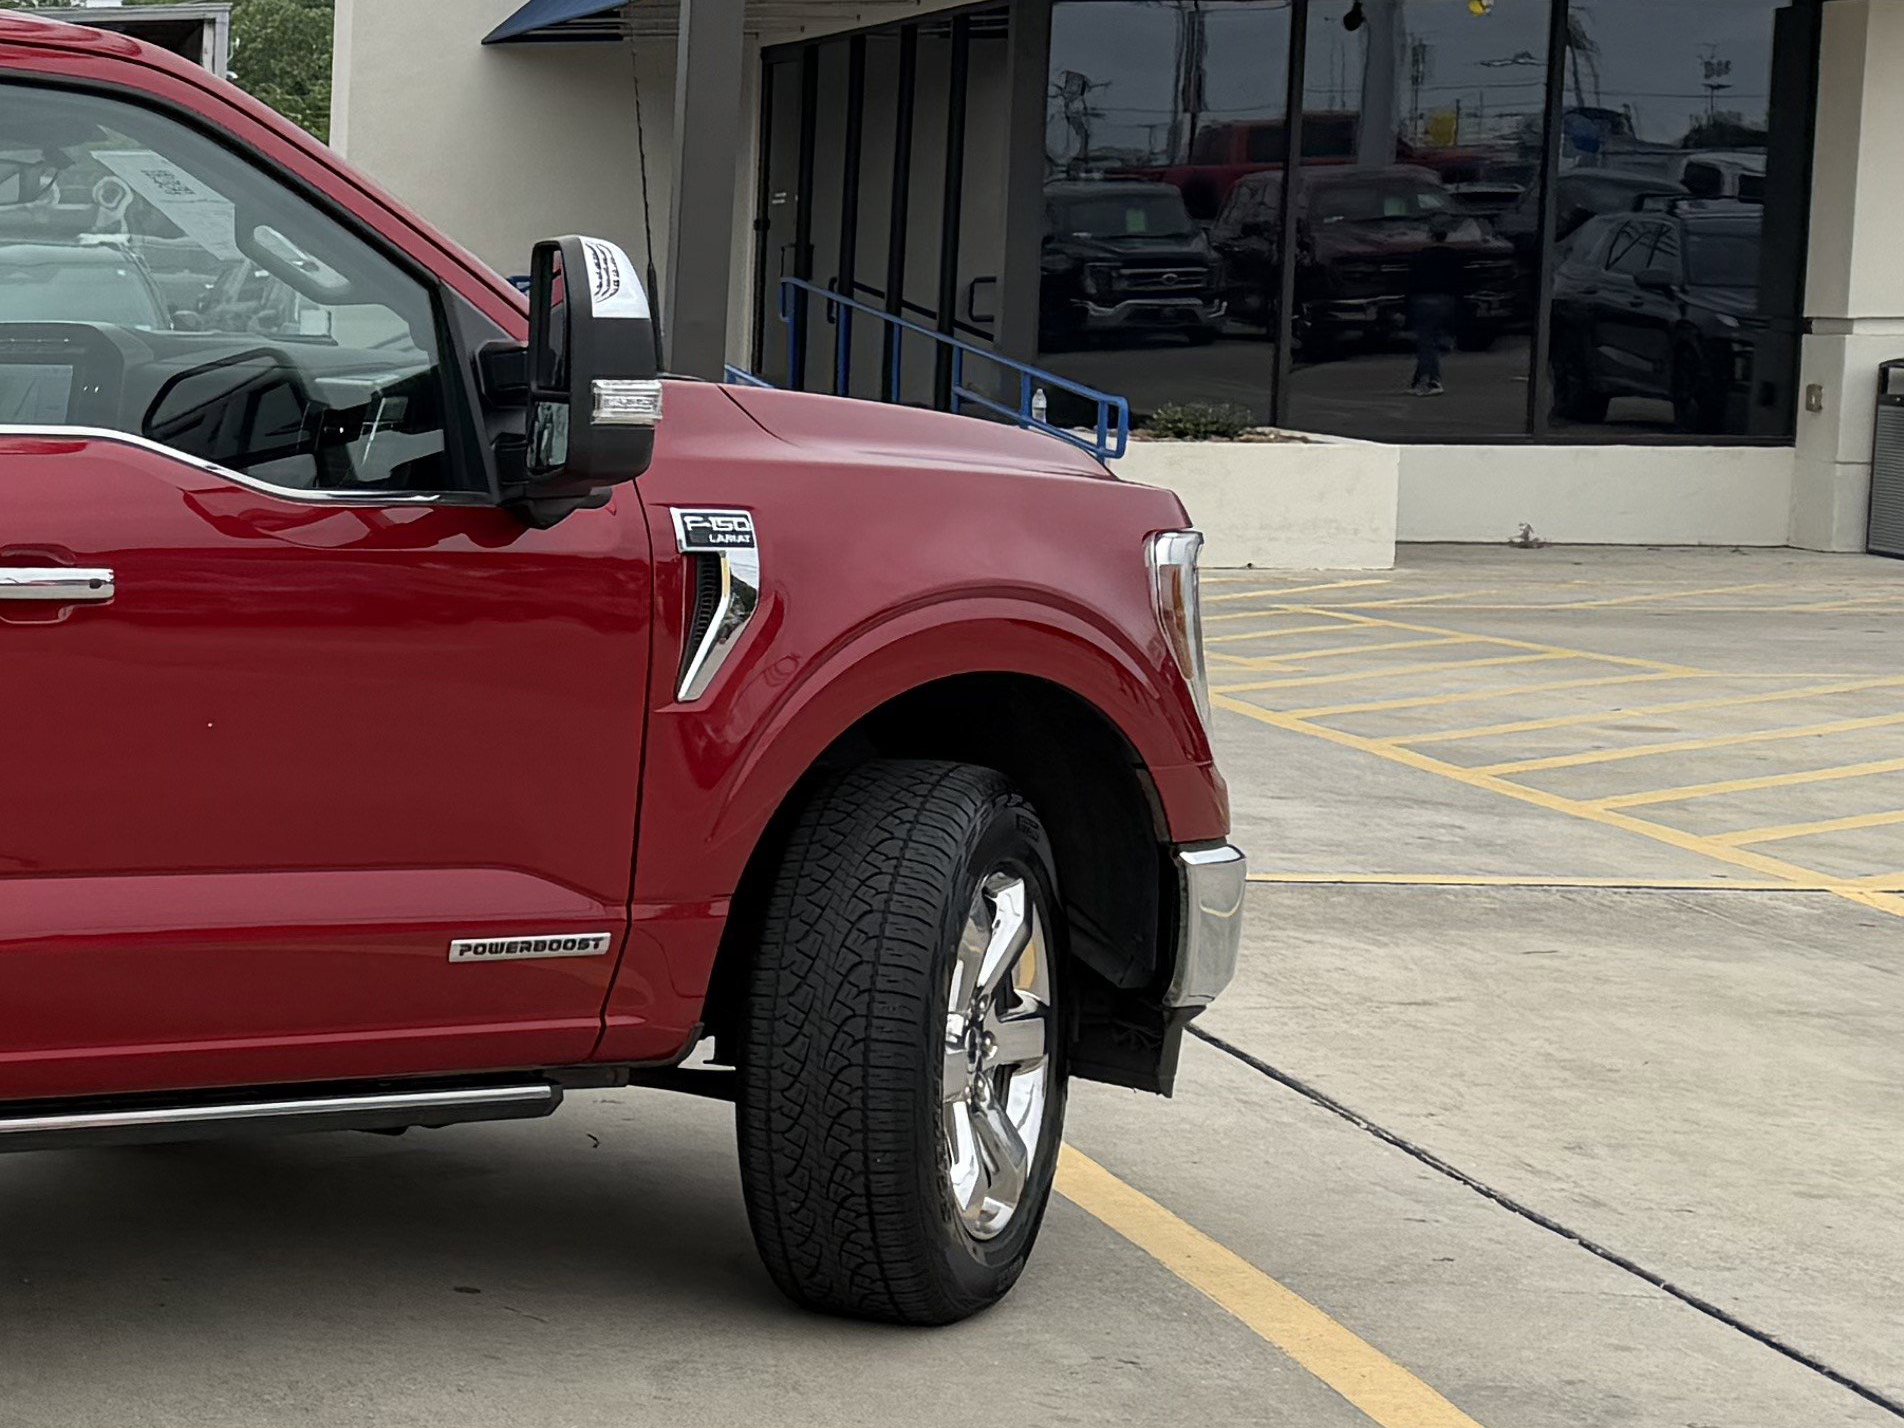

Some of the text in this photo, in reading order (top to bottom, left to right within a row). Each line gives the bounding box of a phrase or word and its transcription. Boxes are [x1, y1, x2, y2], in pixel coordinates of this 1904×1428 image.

[683, 515, 752, 532] F-150
[708, 533, 751, 544] LARIAT
[458, 937, 605, 956] POWERBOOST
